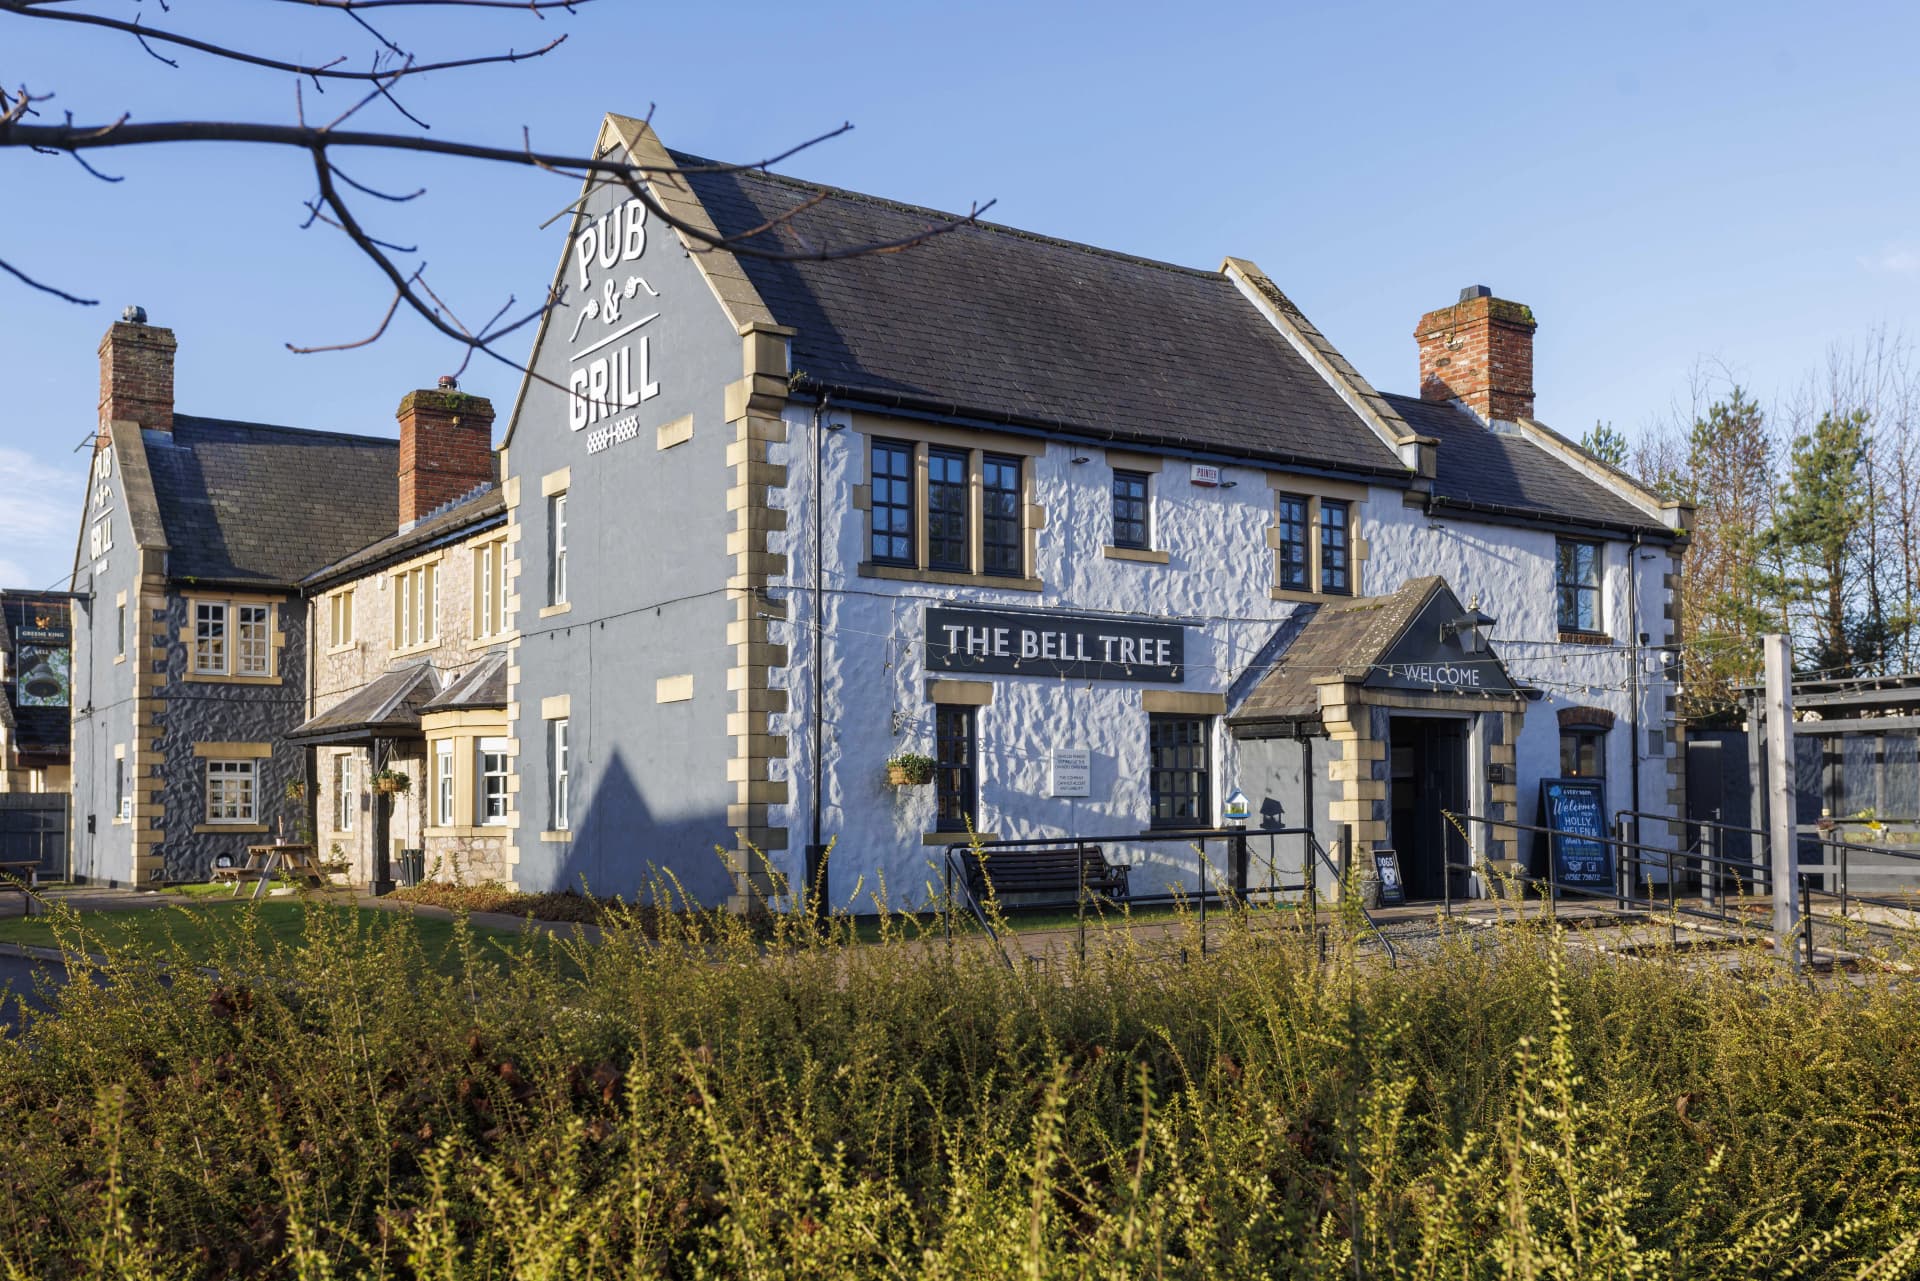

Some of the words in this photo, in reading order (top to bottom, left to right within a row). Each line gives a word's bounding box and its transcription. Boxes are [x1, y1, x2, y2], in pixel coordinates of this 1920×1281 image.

[575, 198, 649, 292] PUB
[603, 278, 623, 325] &
[569, 336, 660, 433] GRILL
[94, 446, 112, 489] PUB
[90, 517, 114, 561] GRILL
[942, 624, 1010, 656] THE
[1022, 629, 1093, 661] BELL
[1099, 634, 1172, 667] TREE
[1403, 664, 1480, 686] WELCOME
[1553, 798, 1597, 816] Welcome
